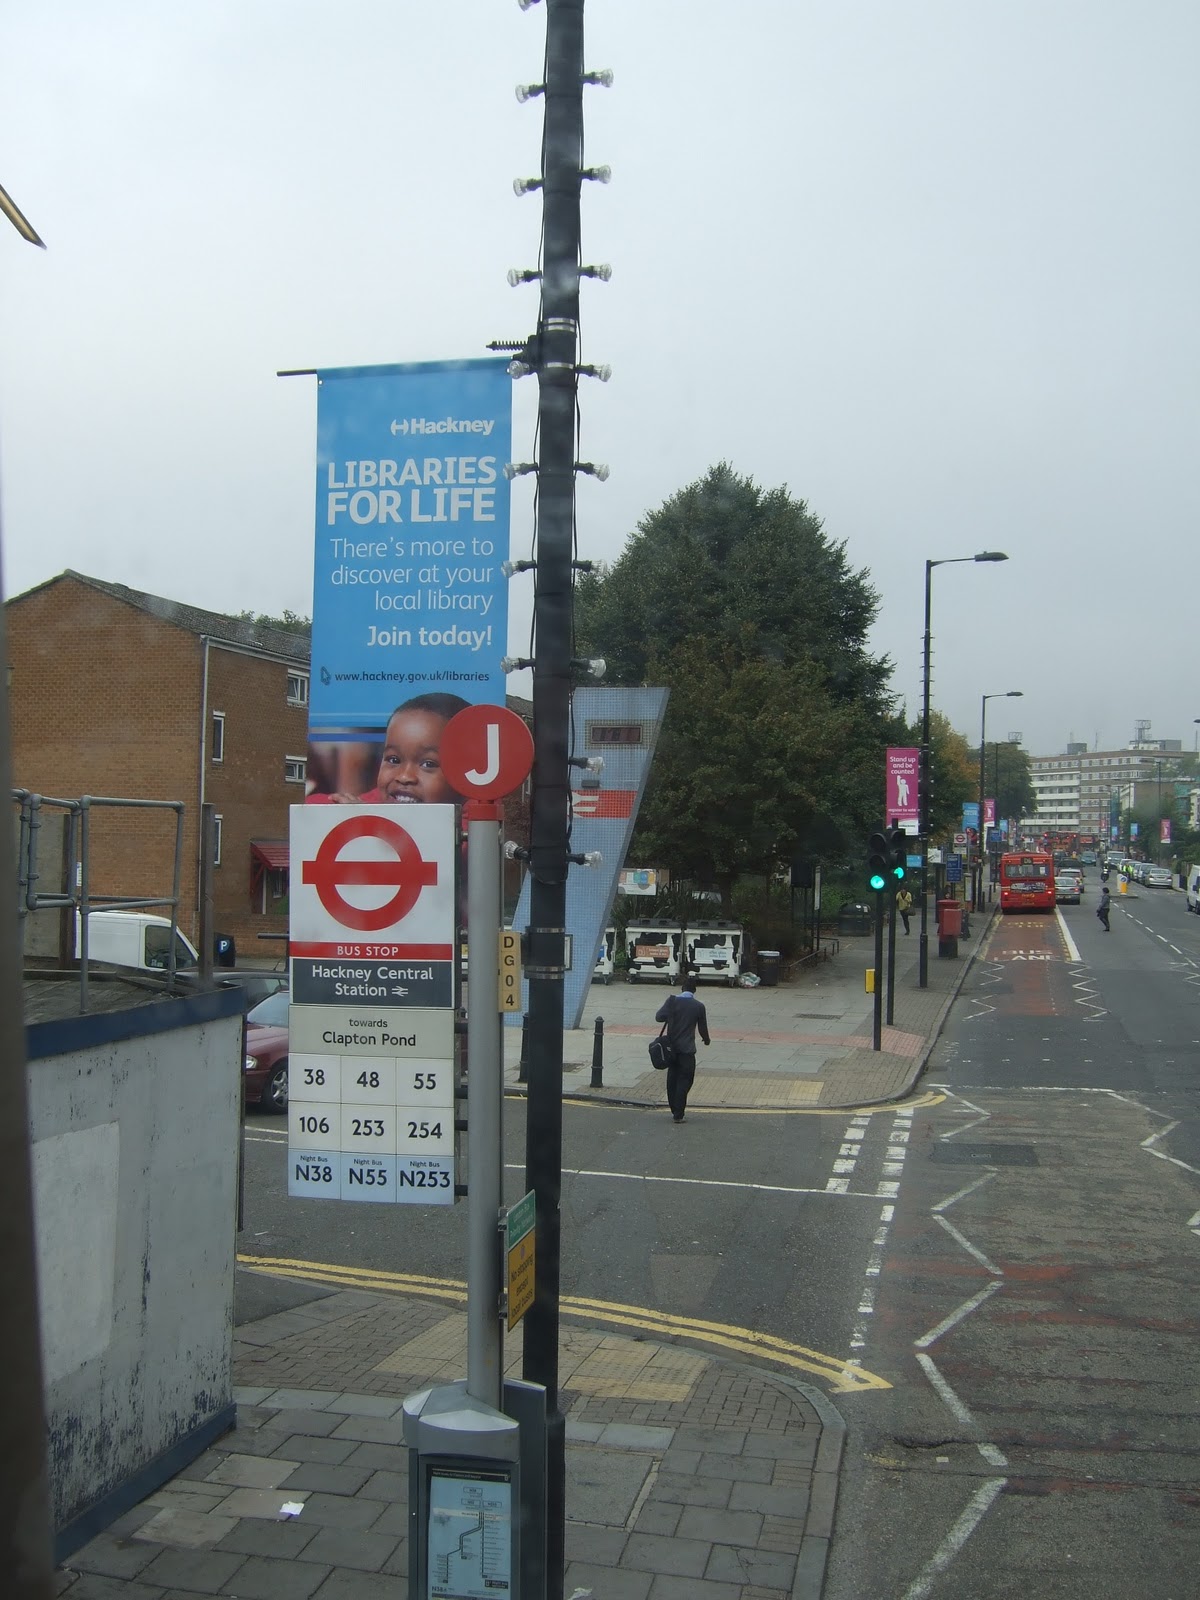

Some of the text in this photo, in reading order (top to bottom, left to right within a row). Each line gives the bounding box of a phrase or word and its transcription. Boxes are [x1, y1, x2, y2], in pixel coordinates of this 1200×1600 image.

[411, 418, 495, 435] Hackney
[327, 456, 497, 489] LIBRARIES
[327, 487, 496, 525] FOR LIFE
[410, 539, 466, 556] more
[472, 536, 494, 556] to
[331, 565, 494, 588] discover at your
[375, 588, 493, 615] local library
[367, 624, 492, 651] Join today!
[335, 667, 490, 683] www.hackney.gov.uk/libraries
[464, 724, 500, 785] J
[221, 941, 228, 950] P
[336, 945, 399, 957] BUS STOP
[312, 965, 434, 981] Hackney Central
[335, 984, 388, 998] Station
[349, 1018, 388, 1028] towards
[322, 1032, 416, 1047] Clapton Pond
[303, 1069, 325, 1086] 38
[357, 1071, 380, 1088] 48
[413, 1073, 437, 1090] 55
[299, 1117, 330, 1134] 106
[352, 1119, 385, 1137] 253
[407, 1122, 442, 1139] 254
[300, 1155, 315, 1163] Night
[353, 1158, 369, 1166] Night
[409, 1160, 427, 1169] Night
[295, 1165, 333, 1183] N38
[348, 1168, 387, 1186] N55
[399, 1170, 450, 1188] N253
